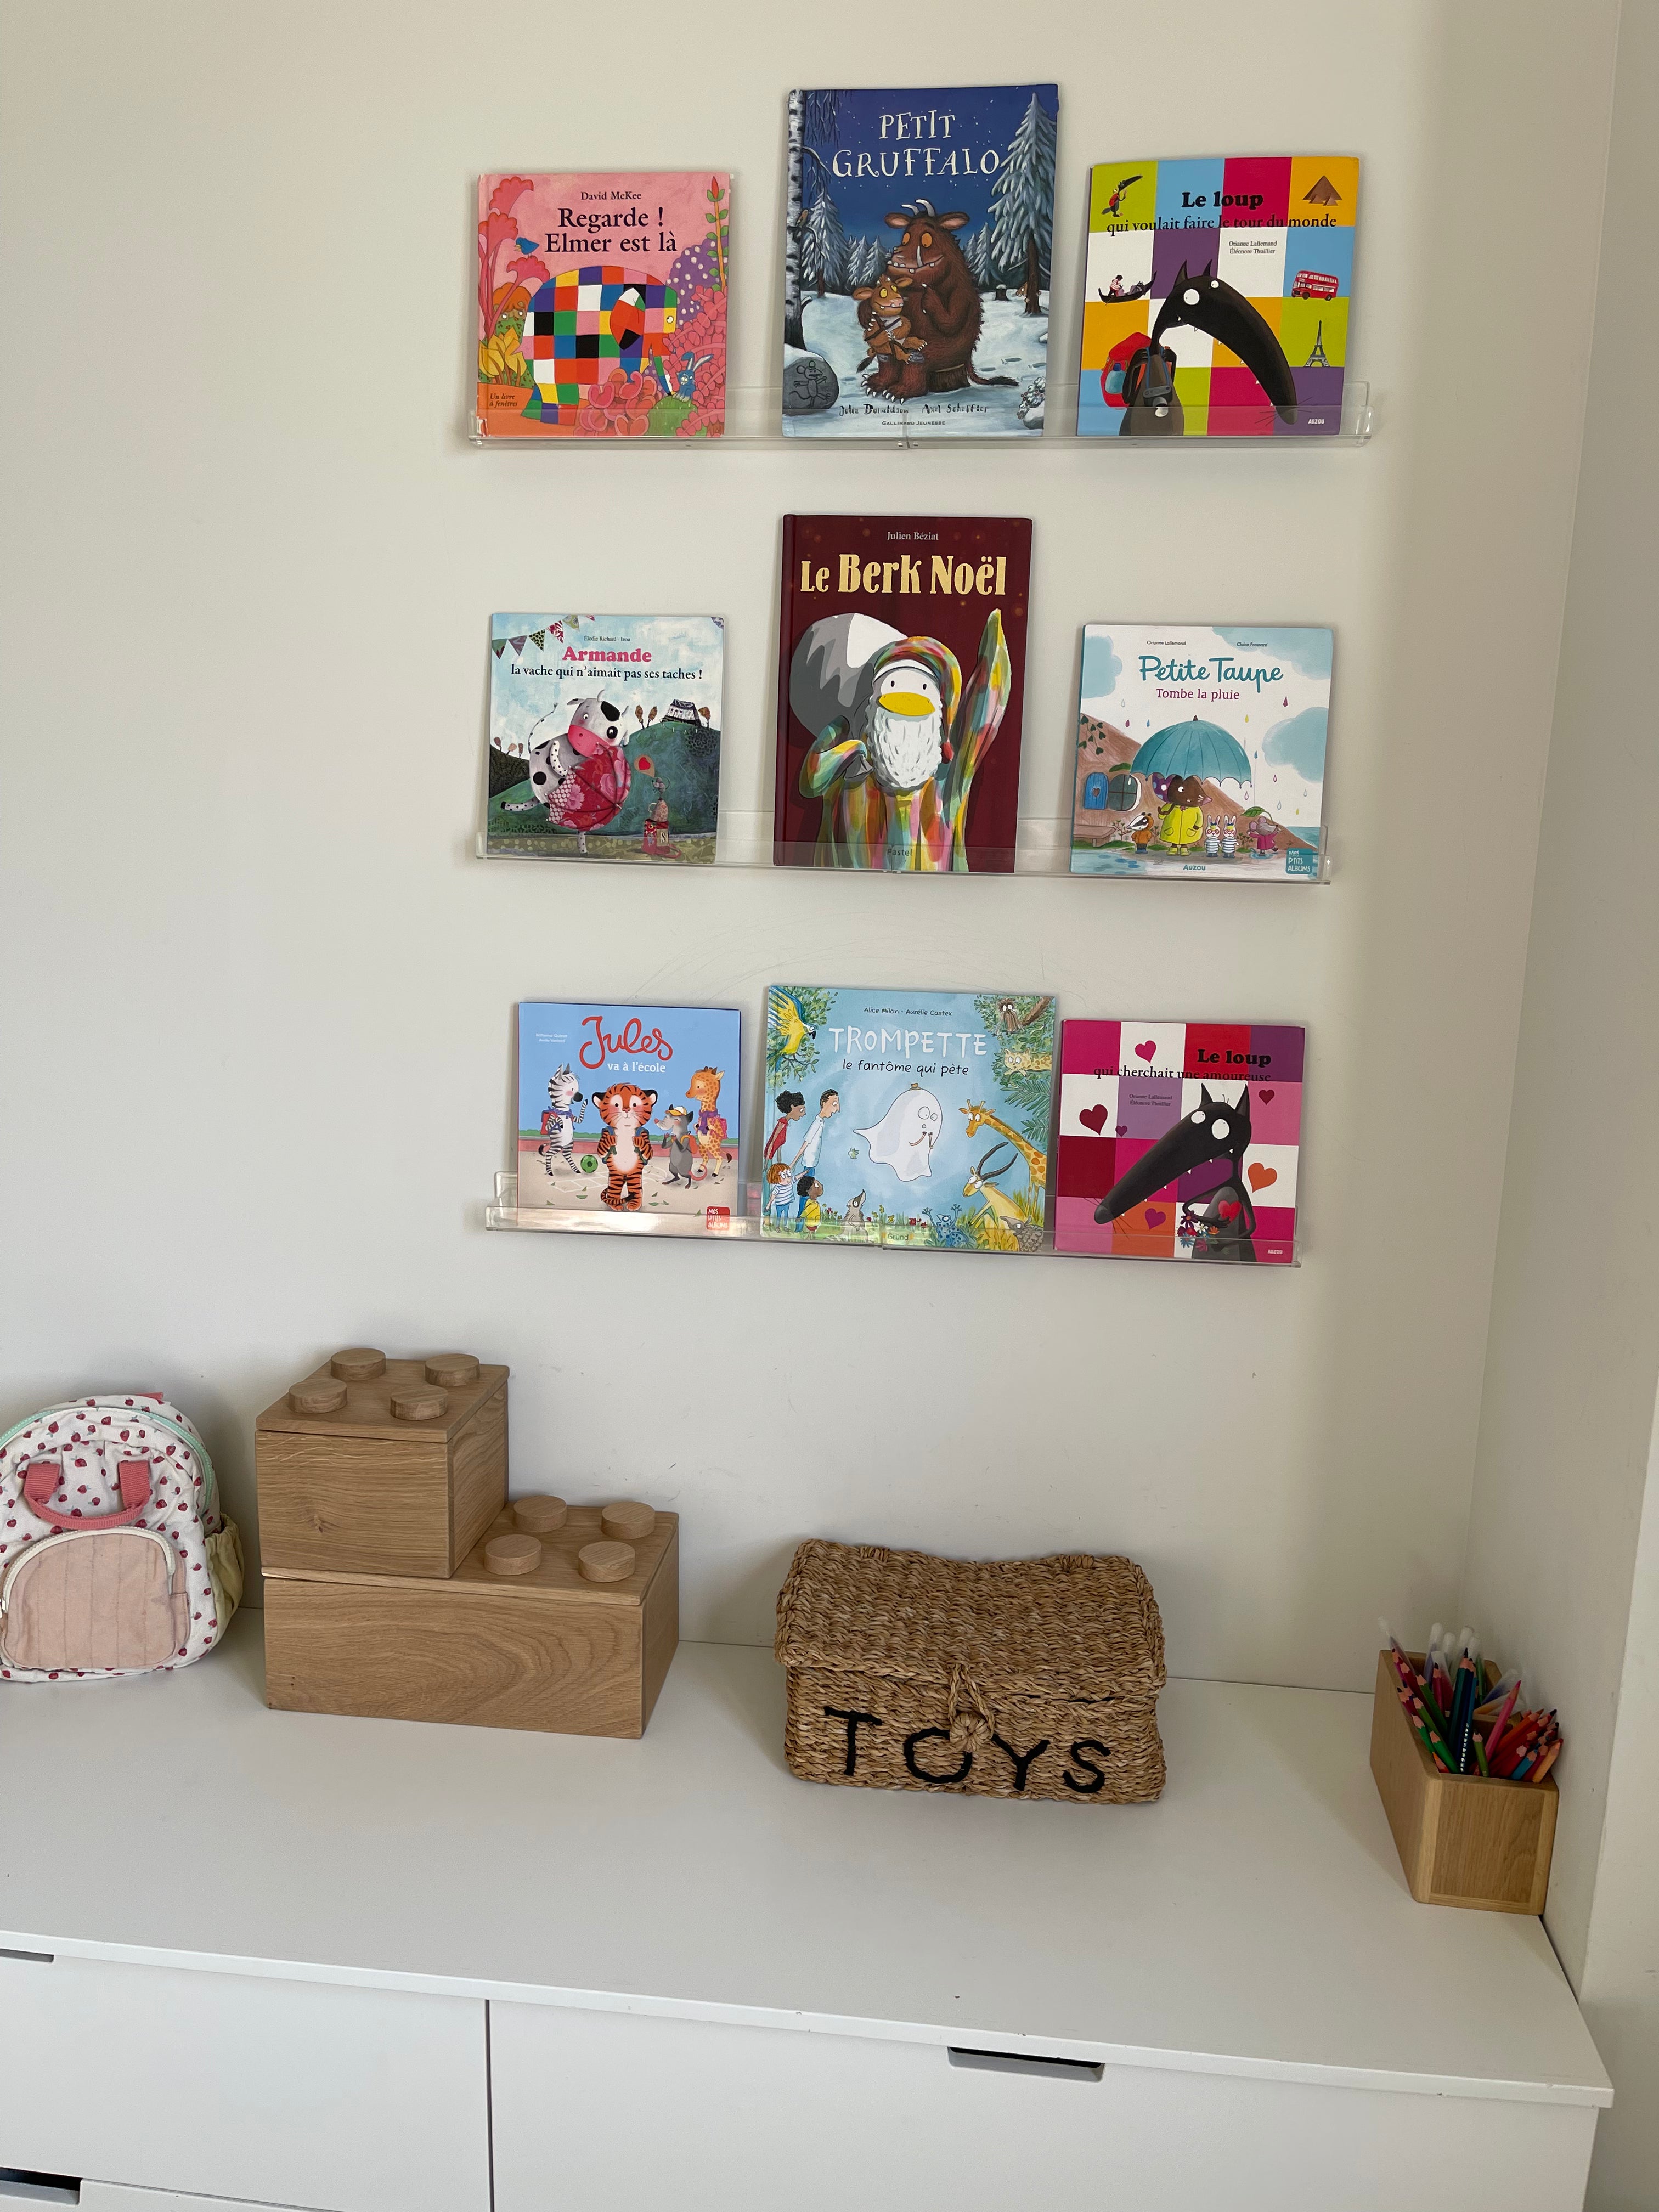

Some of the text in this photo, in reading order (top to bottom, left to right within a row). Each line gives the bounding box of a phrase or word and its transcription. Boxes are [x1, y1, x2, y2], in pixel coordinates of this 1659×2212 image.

[878, 110, 955, 140] PETIT
[832, 148, 1000, 177] GRUFFALO
[580, 191, 641, 200] David McKee
[1182, 191, 1263, 210] Le loup
[557, 207, 649, 233] Regarde
[1107, 213, 1336, 237] qui voulait faire le tour du monde
[544, 231, 678, 252] Elmer est là
[839, 404, 859, 416] Julia
[922, 404, 941, 414] Axel
[887, 531, 939, 540] Julien Béziat
[800, 554, 1006, 595] Le Berk Noël
[562, 646, 652, 662] Armande
[511, 664, 521, 675] la
[523, 664, 553, 676] vache
[556, 667, 573, 679] qui
[624, 670, 641, 681] pas
[645, 670, 659, 679] ses
[662, 668, 696, 679] taches
[1138, 655, 1283, 693] Petite Taupe
[1156, 689, 1240, 702] Tombe la pluie
[579, 1016, 673, 1069] Jules
[828, 1025, 988, 1059] TROMPETTE
[607, 1062, 620, 1071] va
[623, 1061, 629, 1071] à
[843, 1059, 969, 1076] le fantôme qui pète
[1197, 1049, 1272, 1068] Le loup
[1093, 1065, 1272, 1082] qui cherchait une amoureuse
[824, 1707, 1111, 1793] TOYS
